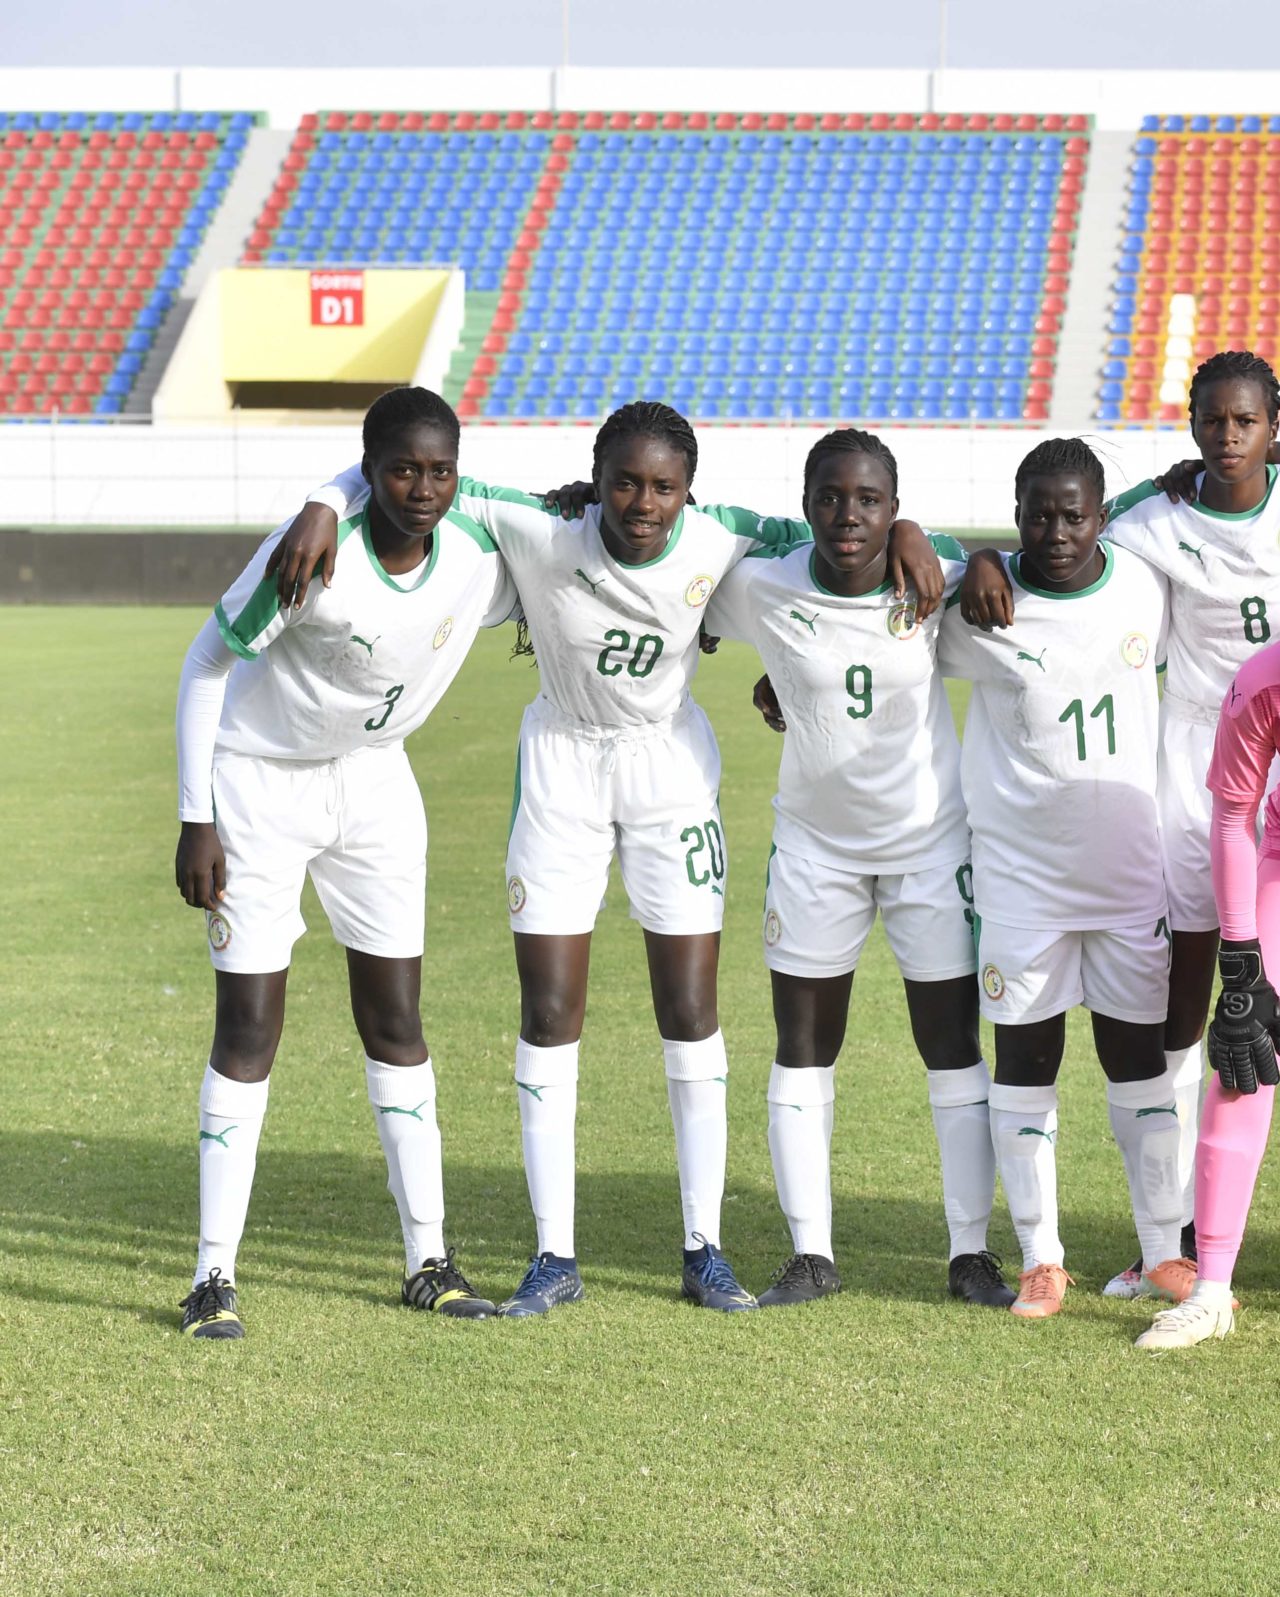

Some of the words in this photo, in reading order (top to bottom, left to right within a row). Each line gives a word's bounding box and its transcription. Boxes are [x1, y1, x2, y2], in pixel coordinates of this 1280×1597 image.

[321, 296, 354, 324] D1
[1240, 596, 1271, 643] 8
[597, 629, 664, 678] 20
[365, 684, 404, 731] 3
[845, 664, 873, 719] 9
[1058, 694, 1116, 761] 11
[680, 819, 724, 887] 20
